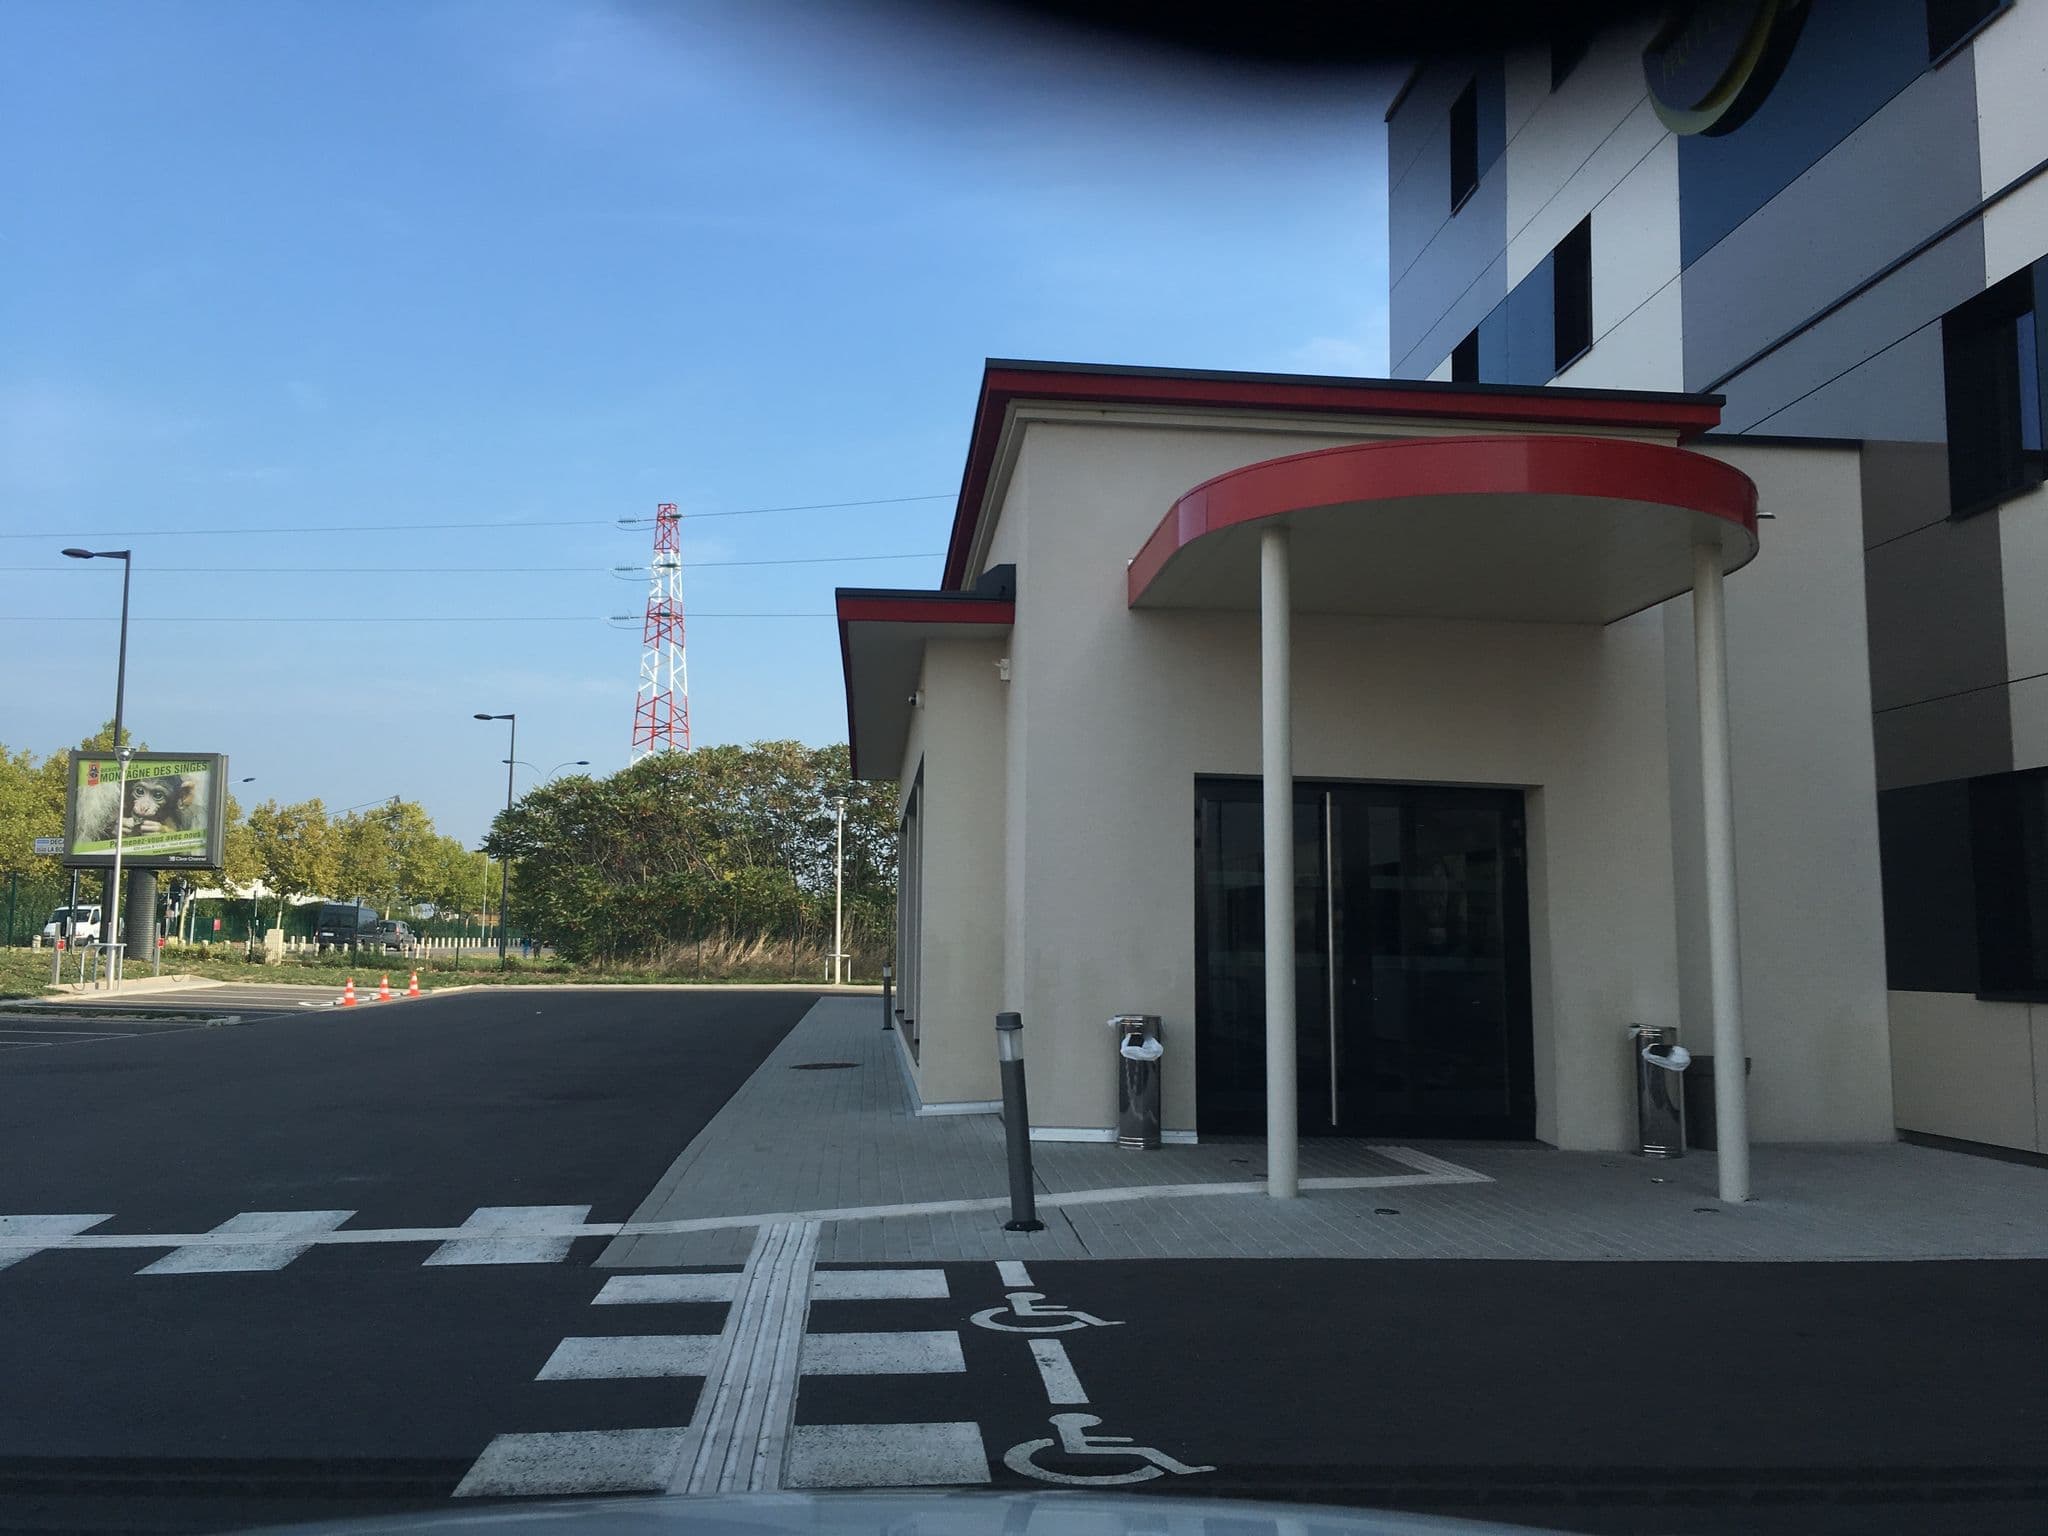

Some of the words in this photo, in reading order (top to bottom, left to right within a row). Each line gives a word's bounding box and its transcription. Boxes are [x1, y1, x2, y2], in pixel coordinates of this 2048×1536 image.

[100, 769, 151, 782] MONAGNE
[154, 765, 171, 776] DES
[174, 762, 207, 774] SINGES
